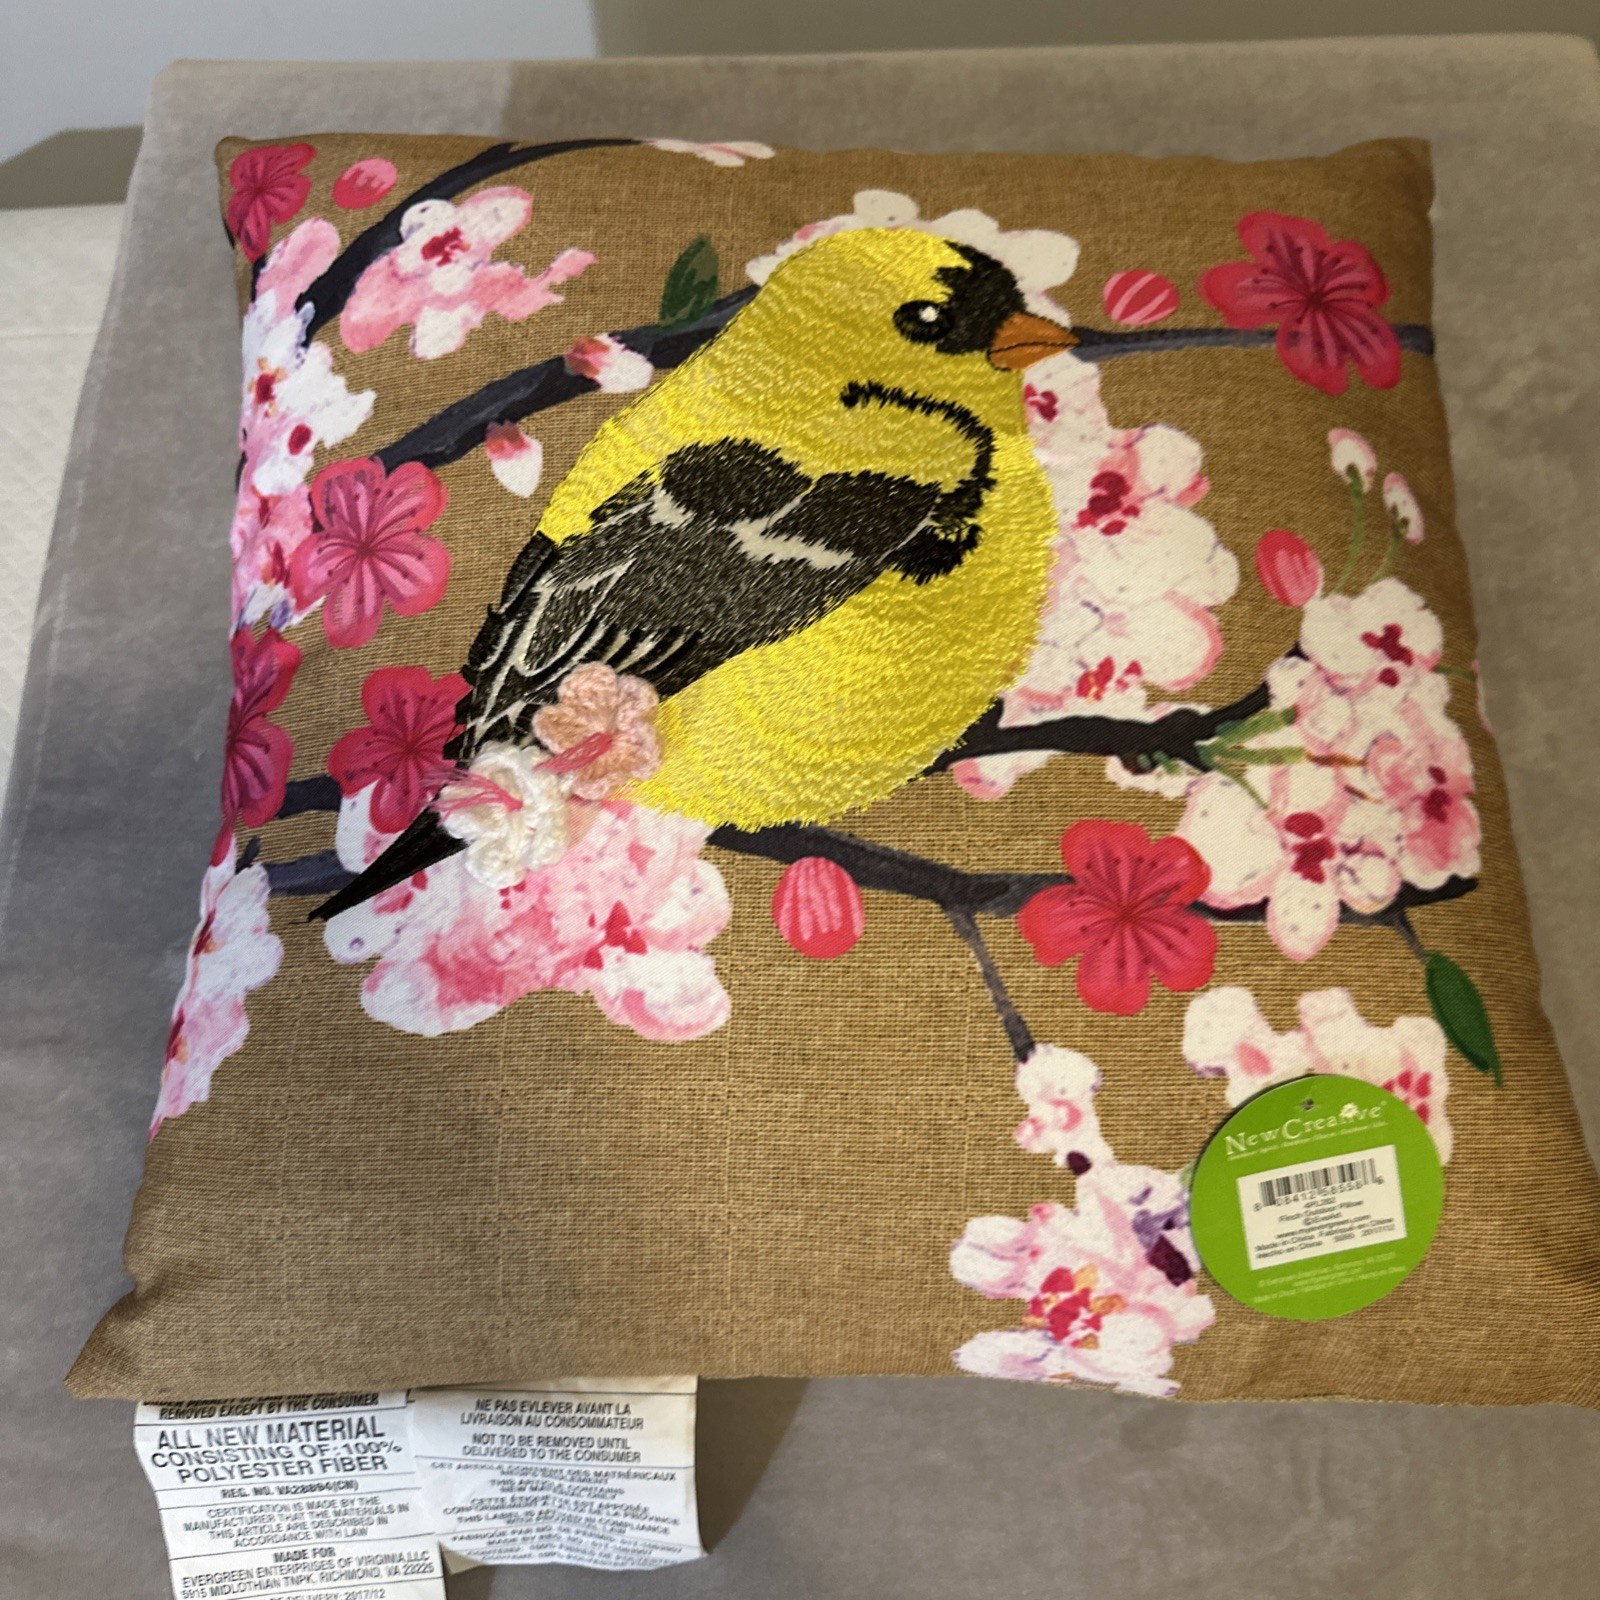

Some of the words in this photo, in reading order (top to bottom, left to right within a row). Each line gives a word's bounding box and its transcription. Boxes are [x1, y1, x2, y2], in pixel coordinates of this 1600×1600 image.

[160, 1406, 217, 1420] REMOVED
[219, 1403, 263, 1417] EXCEPT
[267, 1401, 283, 1414] BY
[286, 1399, 309, 1412] THE
[311, 1392, 379, 1410] CONSUMER
[475, 1399, 493, 1411] NE
[494, 1399, 516, 1413] PAS
[575, 1402, 613, 1415] AVANT
[615, 1403, 632, 1415] LA
[158, 1429, 202, 1450] ALL
[206, 1424, 260, 1447] NEW
[265, 1415, 385, 1444] MATERIAL
[461, 1412, 523, 1426] LIVRAISON
[525, 1415, 542, 1428] AU
[544, 1415, 644, 1430] CONSOMMATEUR
[472, 1433, 497, 1445] NOT
[499, 1435, 515, 1446] TO
[517, 1435, 535, 1447] BE
[537, 1435, 595, 1449] REMOVED
[597, 1438, 631, 1450] UNTIL
[151, 1445, 294, 1468] CONSISTING
[462, 1445, 527, 1459] DELIVERED
[530, 1447, 546, 1460] TO
[548, 1448, 571, 1461] THE
[573, 1450, 641, 1463] CONSUMER
[178, 1459, 315, 1483] POLYESTER
[318, 1455, 389, 1474] FIBER
[183, 1513, 276, 1531] MANUFACTURER
[278, 1511, 306, 1521] THAT
[308, 1510, 329, 1519] THE
[332, 1503, 396, 1517] MATERIALS
[397, 1502, 411, 1513] IN
[207, 1502, 290, 1518] CERTIFICATION
[291, 1502, 304, 1512] IS
[305, 1499, 337, 1510] MADE
[340, 1498, 356, 1508] BY
[358, 1495, 381, 1506] THE
[208, 1528, 235, 1539] THIS
[237, 1523, 283, 1536] ARTICLE
[286, 1521, 308, 1531] ARE
[310, 1516, 374, 1529] DESCRIBED
[376, 1515, 389, 1525] IN
[233, 1530, 312, 1547] ACCORDANCE
[314, 1529, 342, 1539] WITH
[343, 1527, 369, 1538] LAW
[273, 1549, 308, 1562] MADE
[311, 1547, 336, 1558] FOR
[182, 1569, 254, 1588] EVERGREEN
[256, 1559, 336, 1579] ENTERPRISES
[338, 1556, 353, 1569] OF
[209, 1578, 281, 1597] MIDLOTHIAN
[385, 1565, 401, 1577] VA
